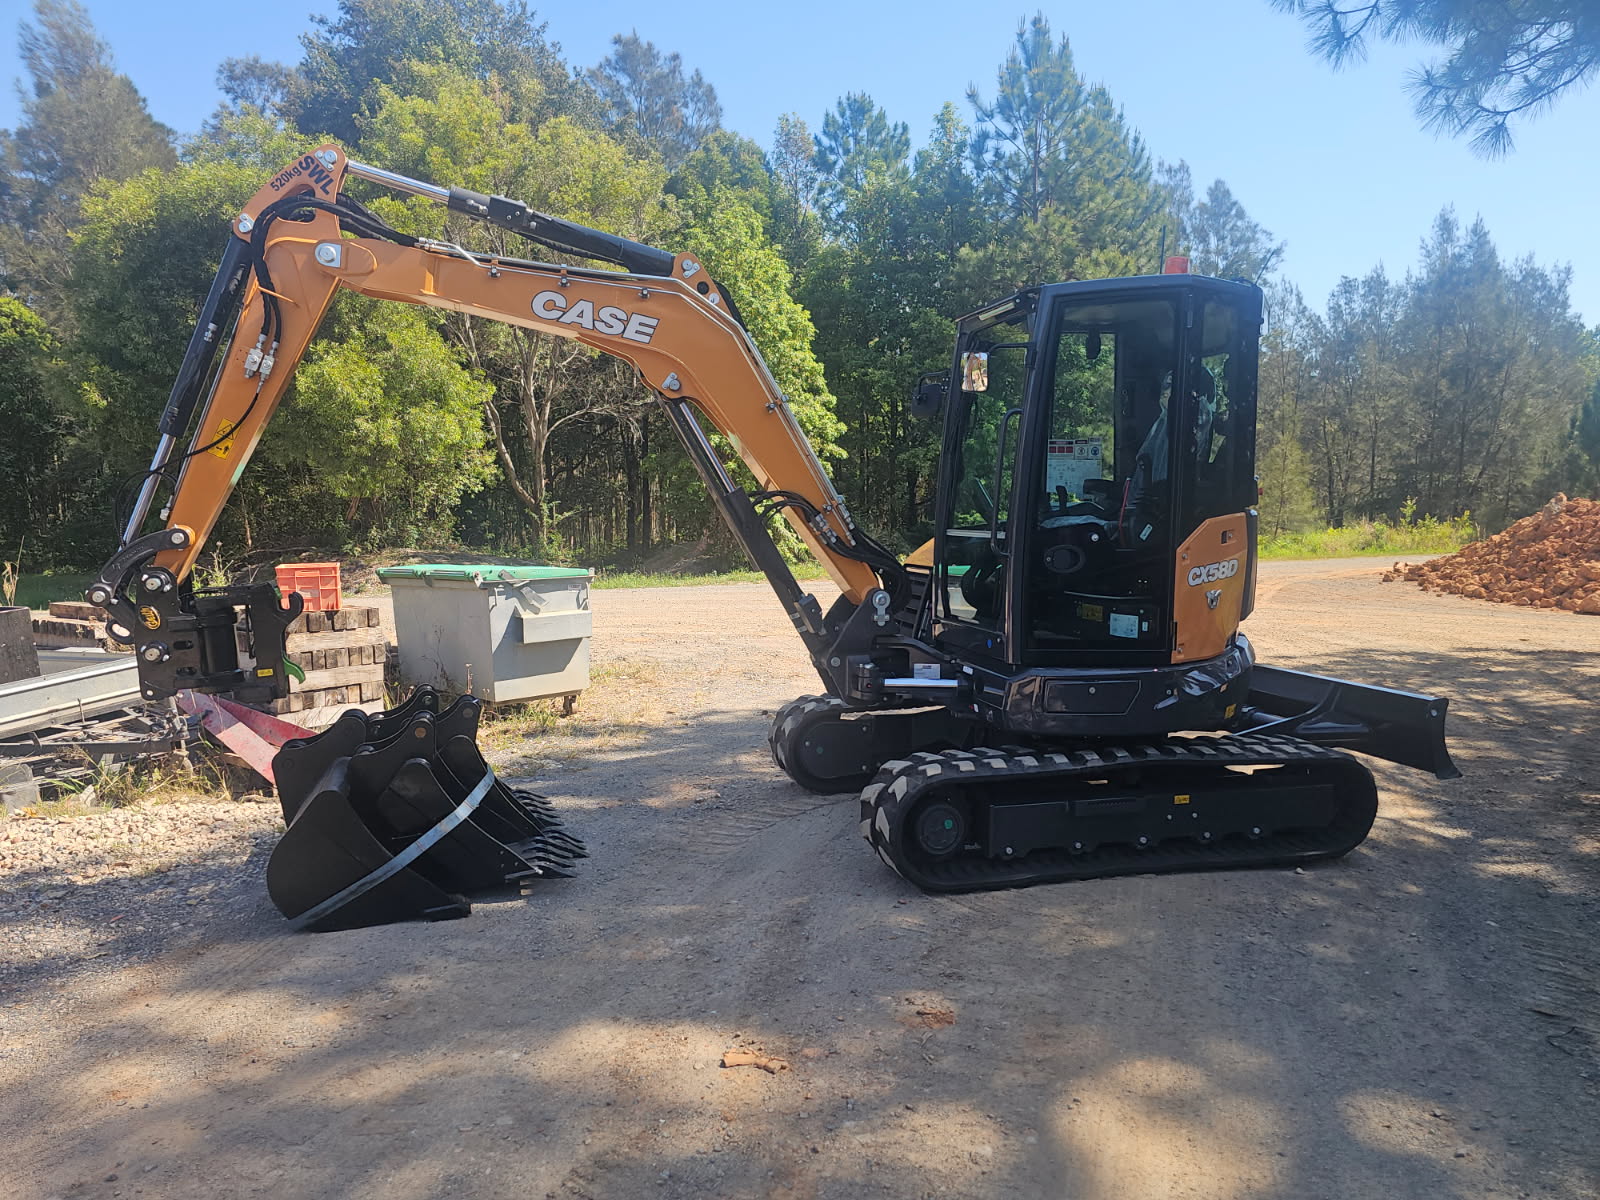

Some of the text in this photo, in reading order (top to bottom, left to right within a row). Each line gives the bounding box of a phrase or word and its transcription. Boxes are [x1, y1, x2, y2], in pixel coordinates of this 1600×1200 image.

[270, 166, 302, 191] 520kg
[299, 155, 334, 195] SWL
[531, 290, 660, 344] CASE
